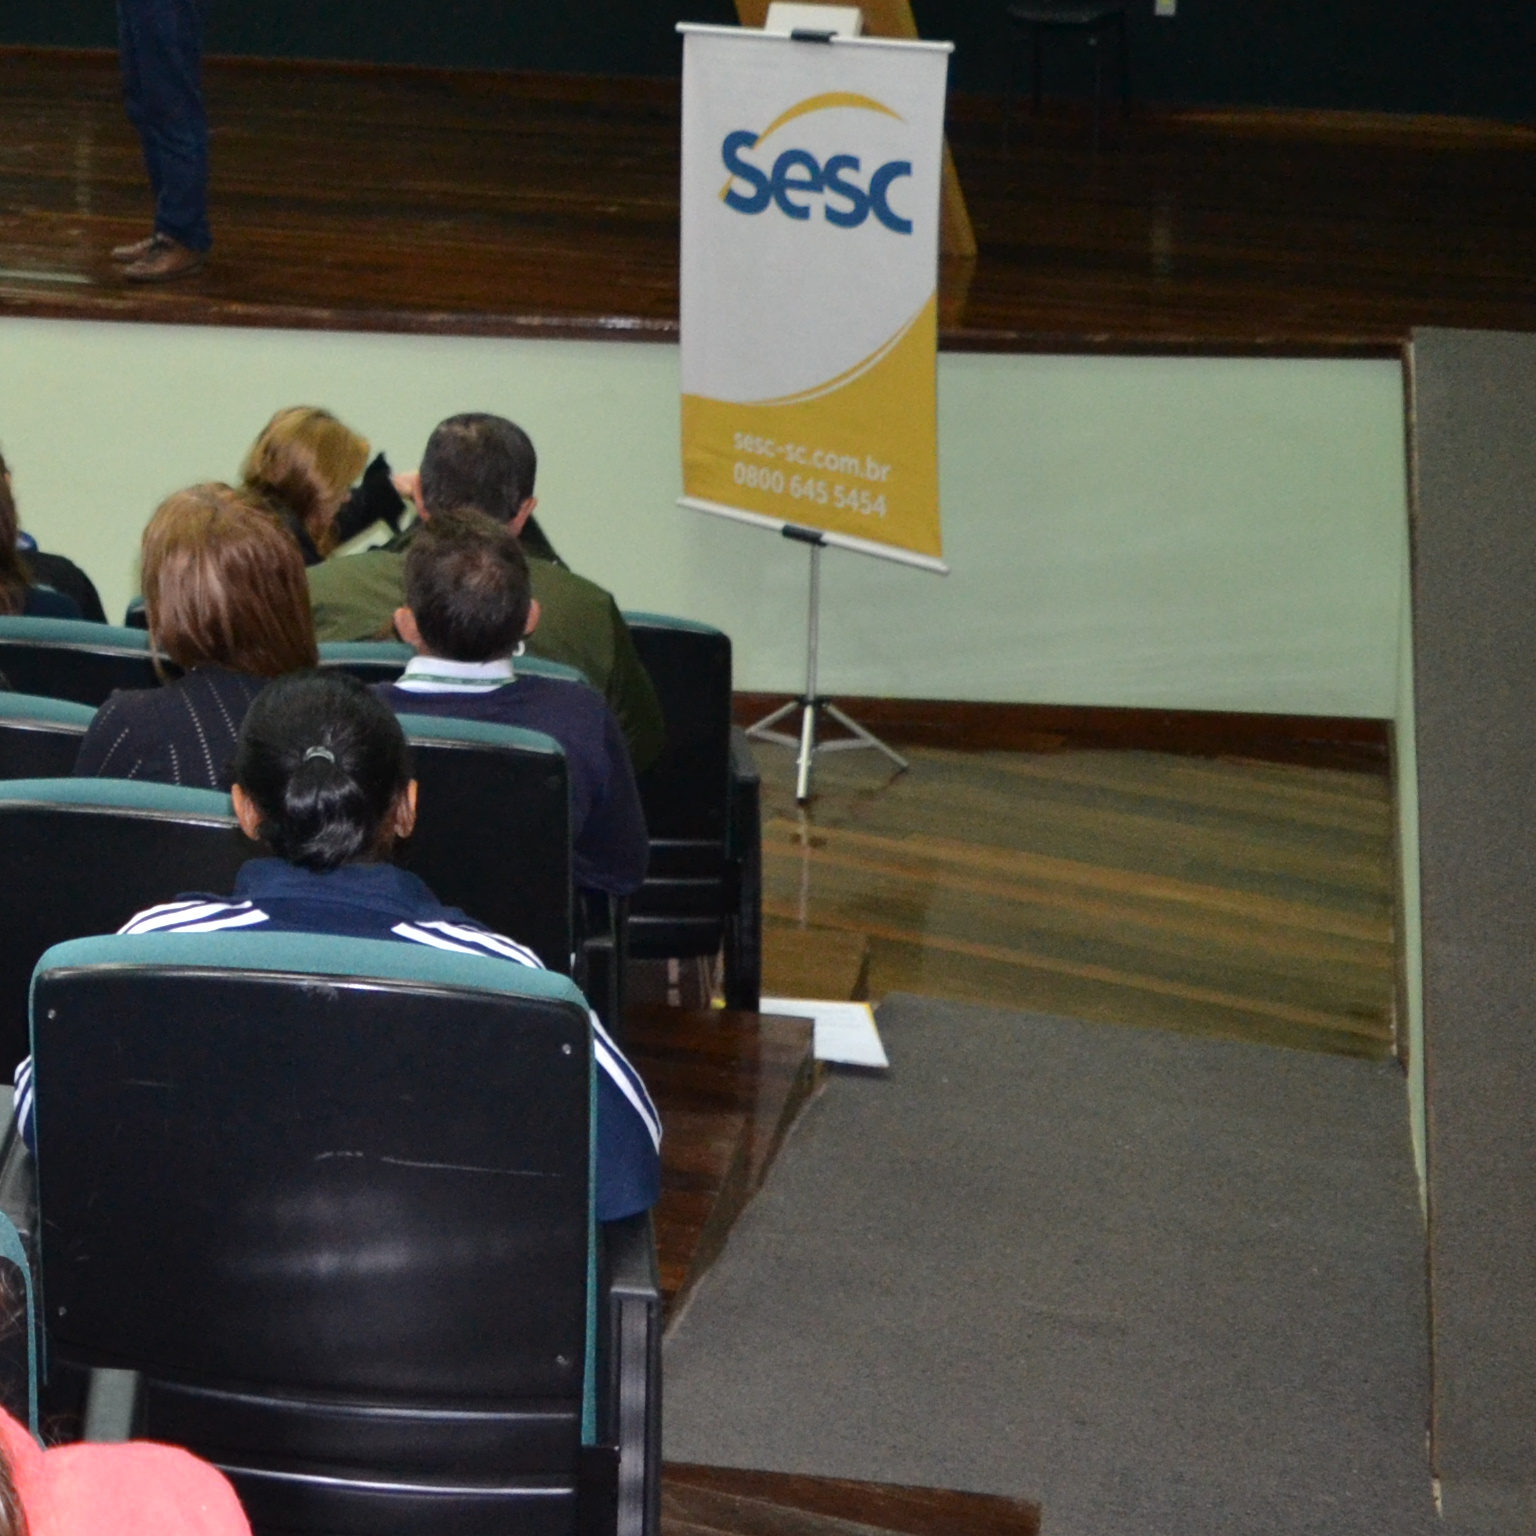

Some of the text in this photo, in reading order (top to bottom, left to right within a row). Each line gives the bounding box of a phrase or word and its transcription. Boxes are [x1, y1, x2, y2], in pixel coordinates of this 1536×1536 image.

[721, 129, 913, 235] Sesc
[733, 431, 892, 482] sesc-sc.com.br
[733, 462, 887, 517] 0800 645 5454
